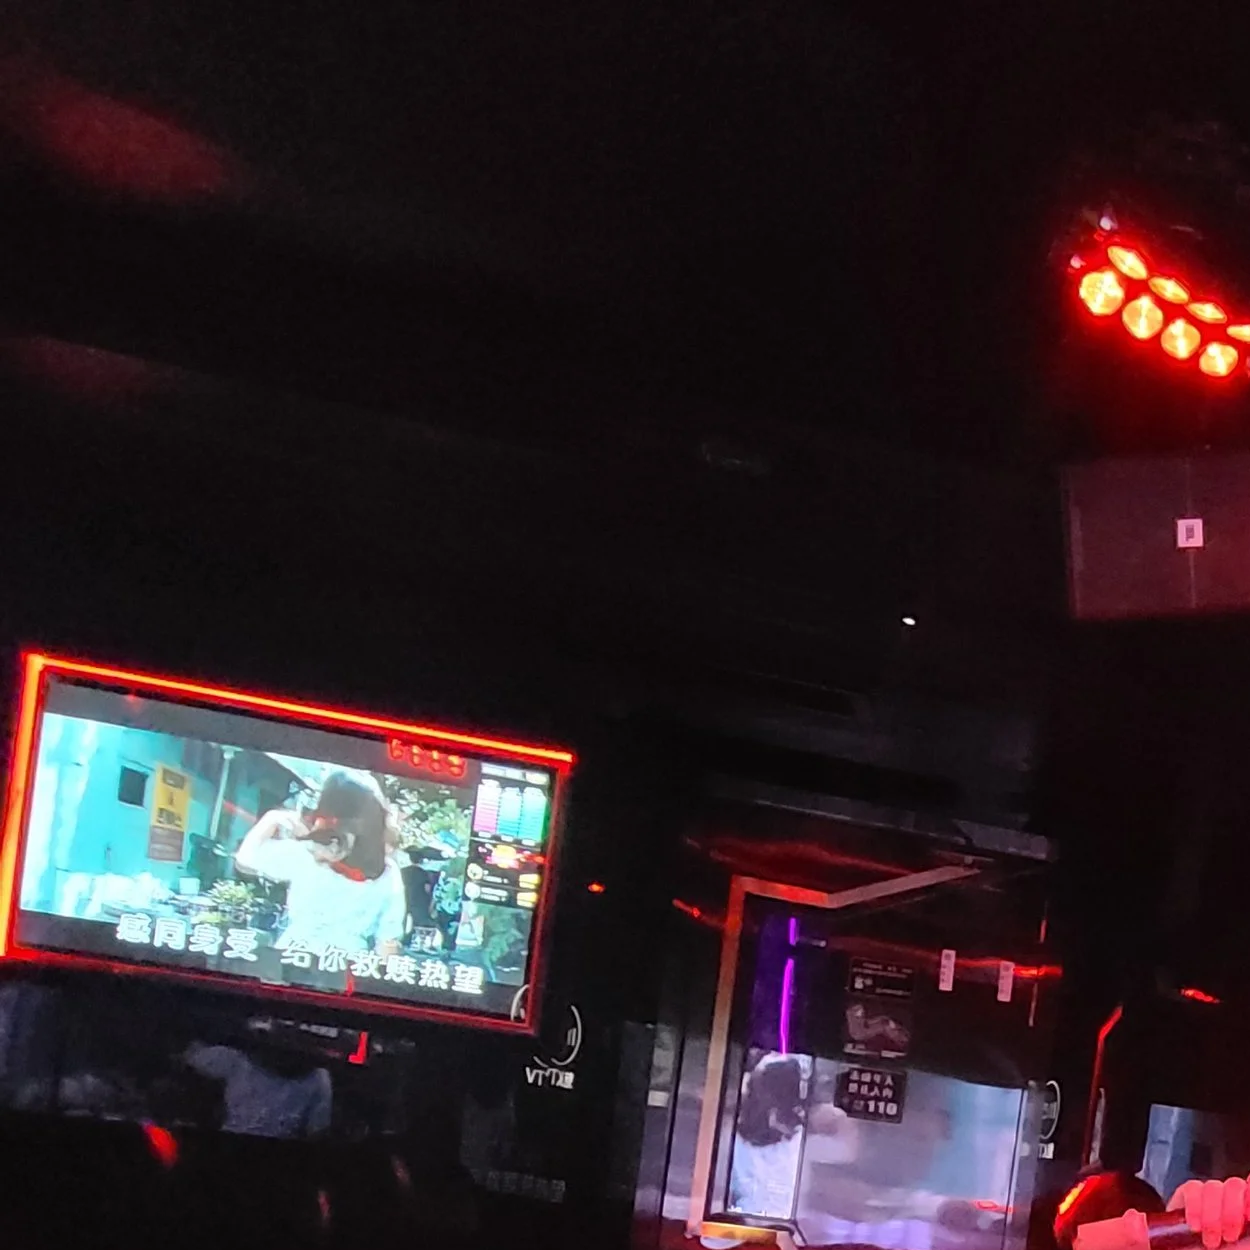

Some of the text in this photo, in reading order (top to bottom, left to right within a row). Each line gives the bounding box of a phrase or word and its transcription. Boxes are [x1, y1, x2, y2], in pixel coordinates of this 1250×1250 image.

[116, 912, 484, 995] 感同身受 给你救赎热望
